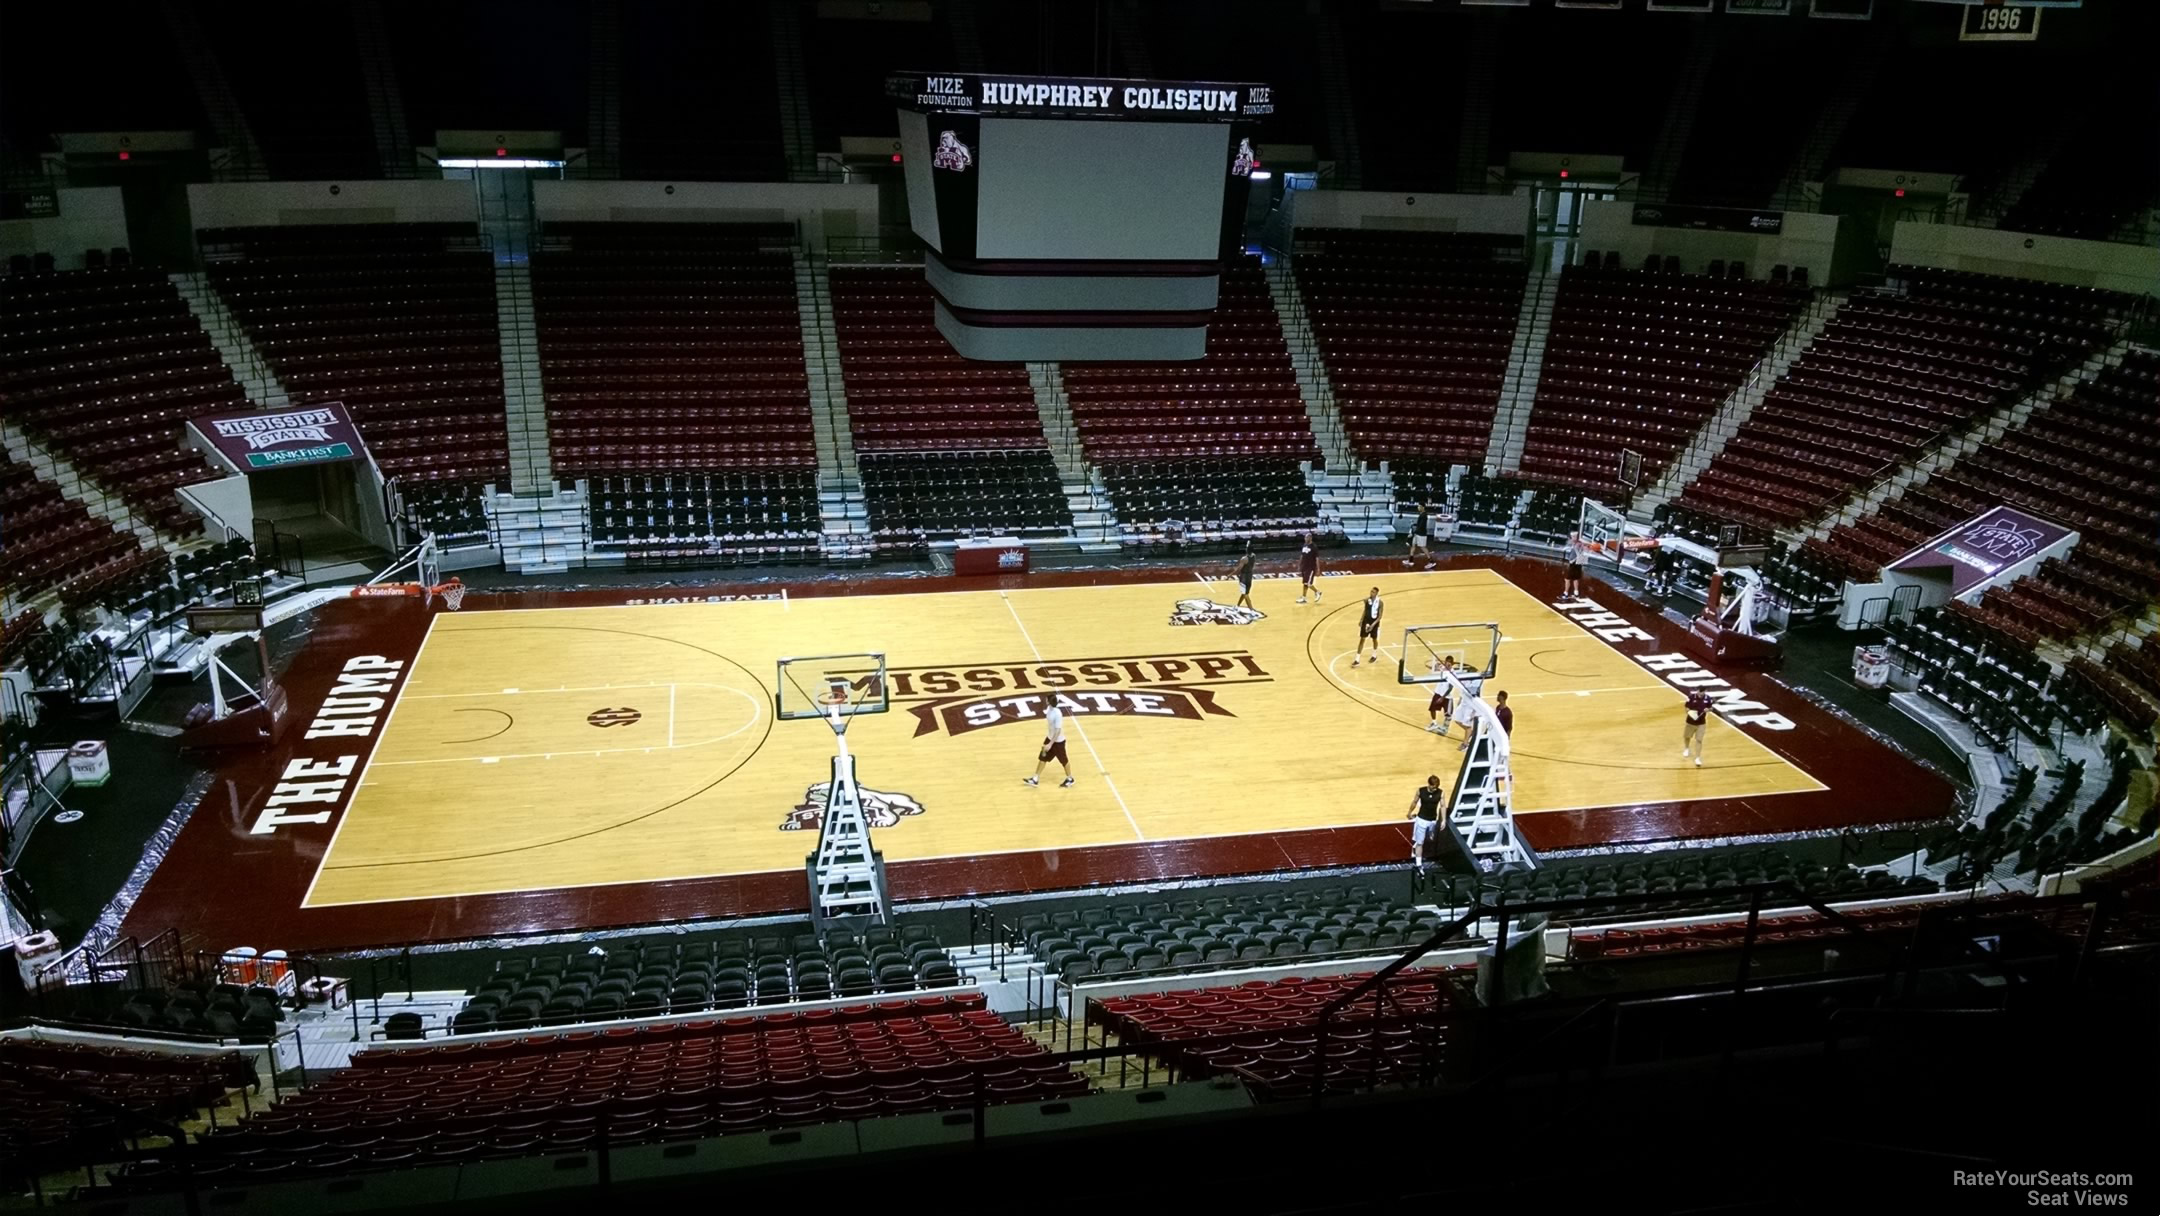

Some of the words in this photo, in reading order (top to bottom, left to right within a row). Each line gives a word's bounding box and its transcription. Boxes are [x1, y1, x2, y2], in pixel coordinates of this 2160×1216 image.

[1980, 8, 2022, 30] 1996
[926, 77, 964, 95] MIZE
[982, 82, 1114, 108] HUMPHREY
[1123, 87, 1238, 112] COLISEUM
[1249, 87, 1271, 104] MIZE
[917, 94, 973, 107] FOUNDATION
[213, 410, 337, 435] MISSISSIPPI
[259, 430, 315, 444] STATE
[1982, 529, 2025, 549] STATE
[1553, 597, 1656, 643] THE
[1633, 652, 1797, 731] HUMP
[824, 655, 1270, 698] MISSISSIPPI
[303, 655, 405, 740] HUMP
[964, 692, 1175, 726] STATE
[587, 707, 642, 728] SEC
[250, 755, 359, 835] THE
